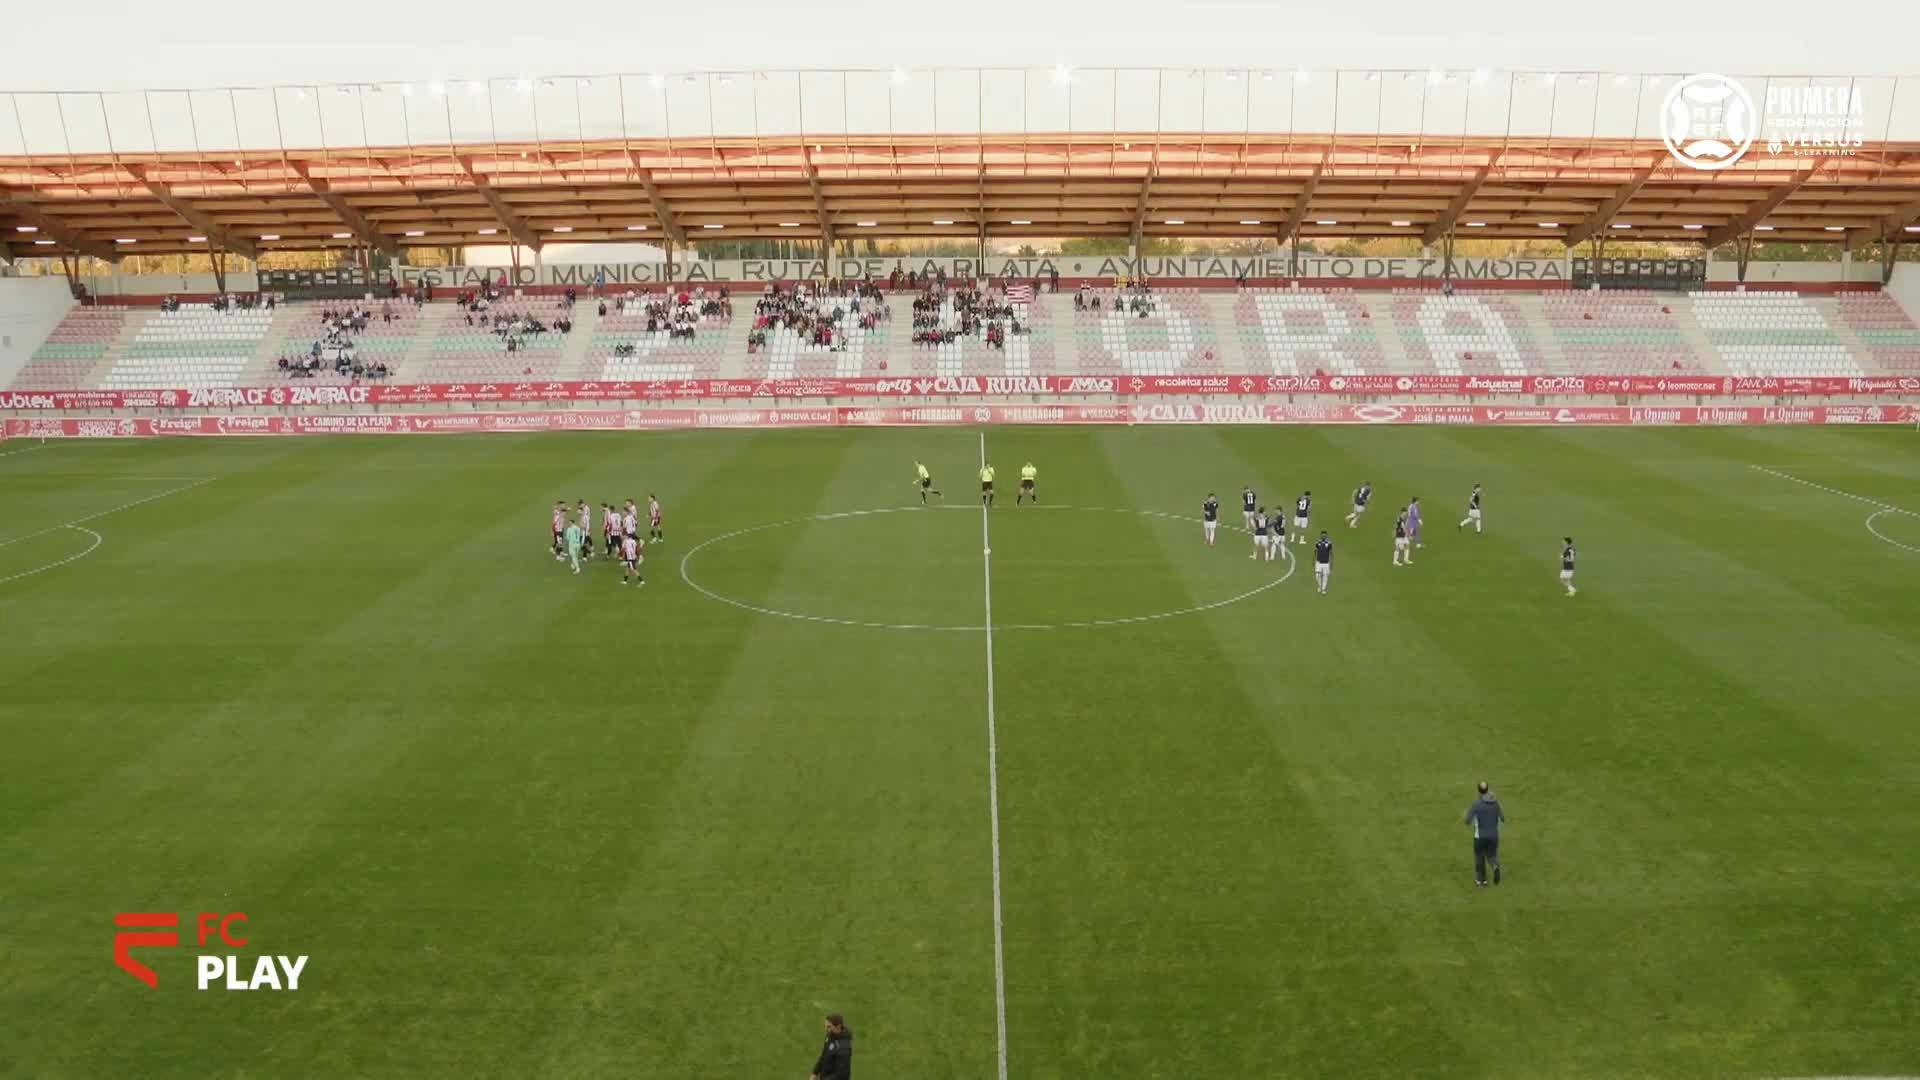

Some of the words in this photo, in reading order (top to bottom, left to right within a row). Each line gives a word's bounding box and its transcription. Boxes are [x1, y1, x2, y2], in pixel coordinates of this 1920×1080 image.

[402, 266, 536, 286] ESTADIO
[552, 263, 729, 285] MUNICIPAL
[742, 259, 828, 281] RUTA
[841, 259, 884, 279] DE
[897, 258, 939, 279] LA
[953, 258, 1054, 278] PLATA
[1098, 257, 1354, 277] AYUNTAMIENTO
[1364, 258, 1404, 279] DE
[1416, 258, 1562, 280] ZAMORA
[934, 377, 981, 394] CAJA
[986, 377, 1054, 394] RURAL
[1154, 377, 1201, 387] recoletas
[1202, 377, 1229, 387] salud
[0, 391, 55, 409] ublex
[187, 388, 246, 407] ZAMORA
[247, 388, 268, 405] CF
[290, 386, 350, 405] ZAMORA
[350, 387, 371, 404] CF
[1150, 404, 1198, 421] CAJA
[1202, 404, 1270, 421] RURAL
[1630, 407, 1641, 420] La
[1644, 406, 1681, 422] Opinión
[1696, 407, 1709, 420] La
[1711, 406, 1748, 422] Opinión
[1763, 407, 1775, 420] La
[1778, 406, 1815, 422] Opinión
[313, 416, 345, 427] CAMINO
[346, 416, 357, 426] DE
[358, 416, 370, 426] LA
[370, 416, 393, 426] PLATA
